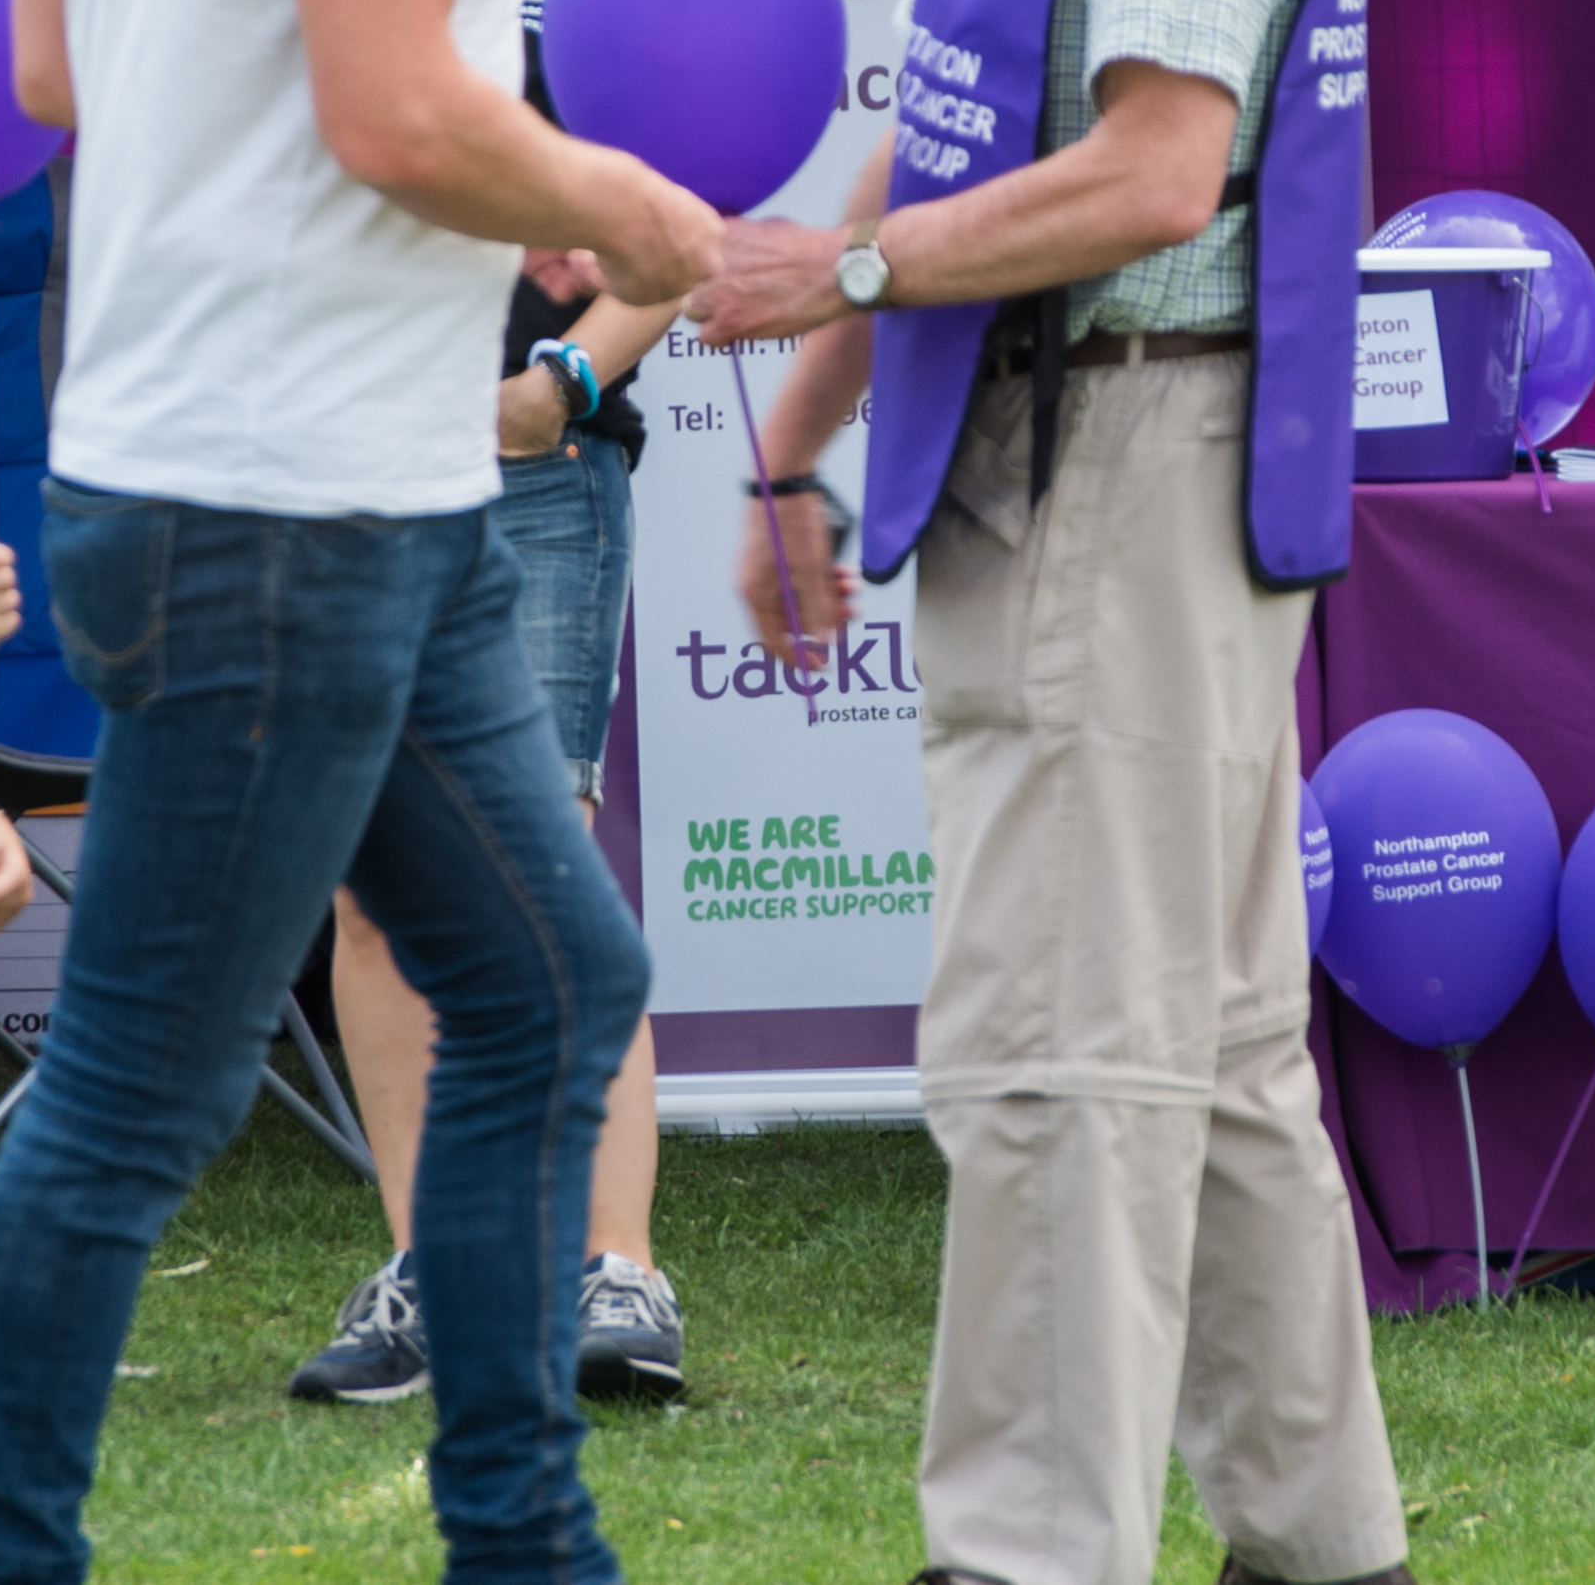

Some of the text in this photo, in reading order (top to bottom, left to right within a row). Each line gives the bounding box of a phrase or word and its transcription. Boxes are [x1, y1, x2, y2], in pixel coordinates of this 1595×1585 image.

[668, 402, 724, 432] Tel:
[676, 621, 924, 700] tackl
[688, 815, 841, 853] WE ARE
[1373, 828, 1490, 857] Northampton
[683, 851, 937, 893] MACMILLAN
[1362, 851, 1505, 881] Prostate Cancer
[1372, 874, 1502, 902] Support Group
[687, 891, 934, 922] CANCER SUPPORT
